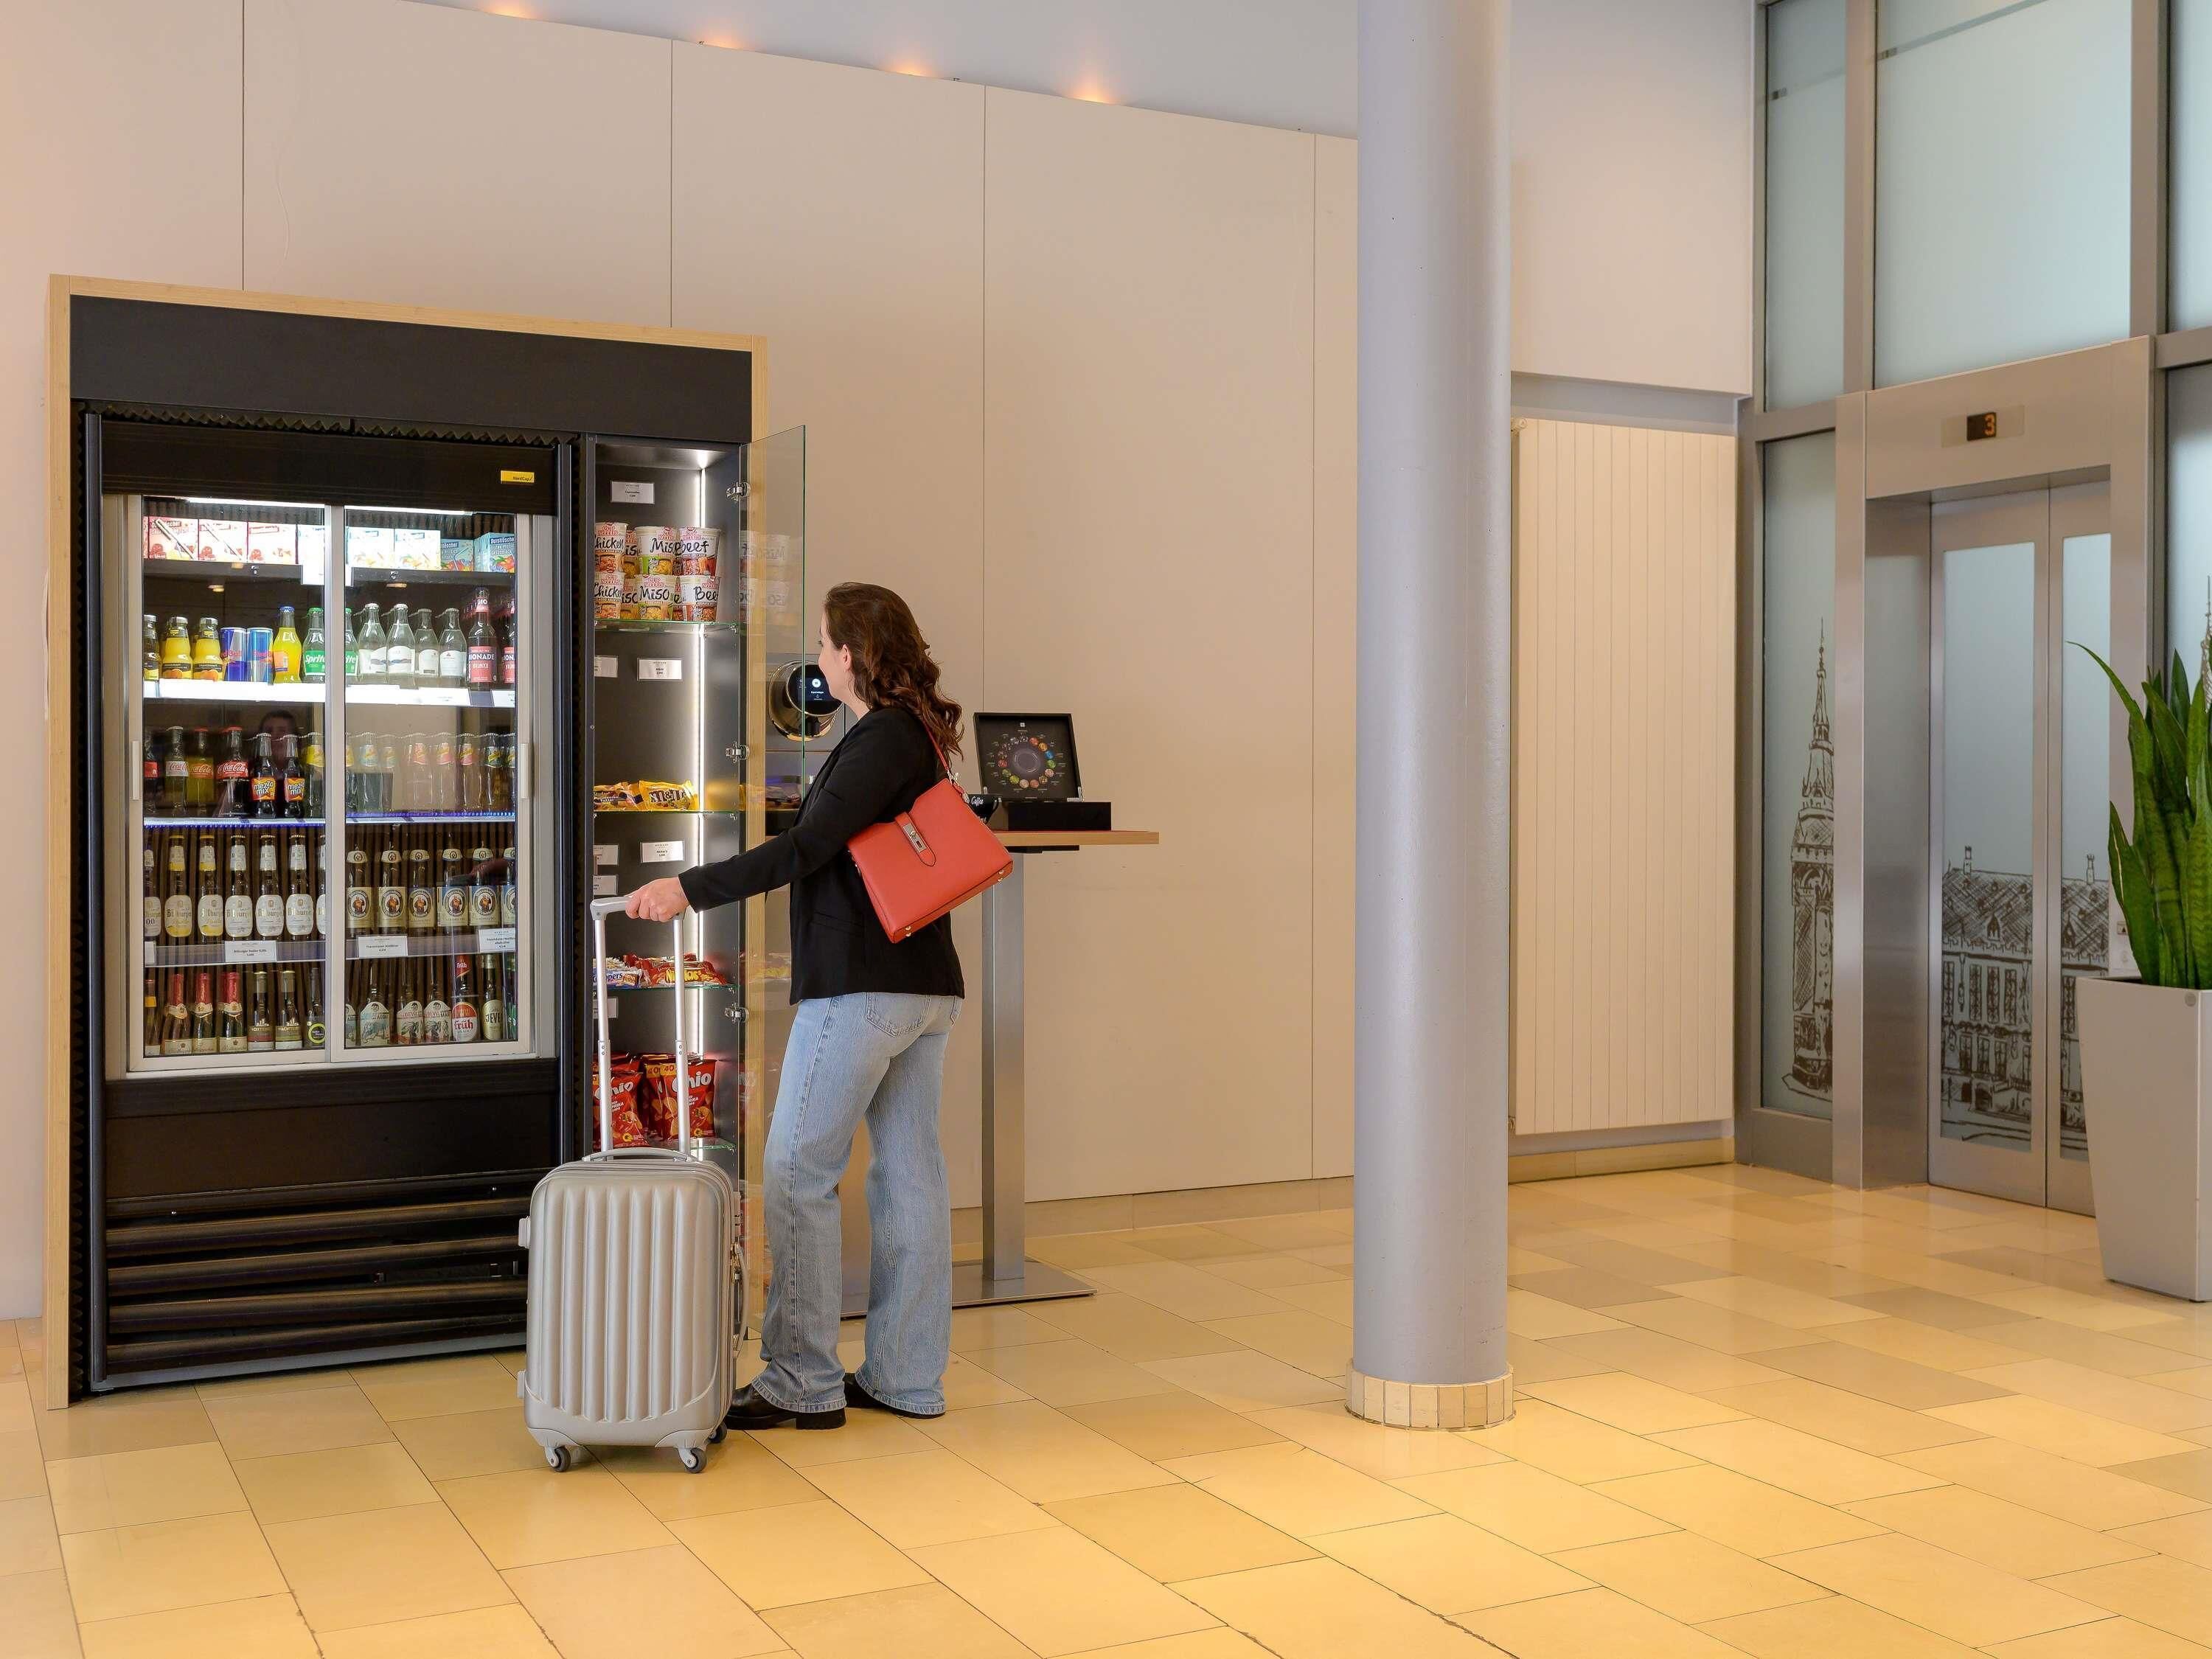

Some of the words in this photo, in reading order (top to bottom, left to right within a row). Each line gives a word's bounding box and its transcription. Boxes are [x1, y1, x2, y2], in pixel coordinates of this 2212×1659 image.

[1983, 414, 1994, 436] 3
[594, 536, 624, 549] hicken
[625, 545, 638, 555] is
[594, 582, 622, 598] Chicke
[640, 585, 669, 601] Miso
[693, 586, 719, 601] Bee
[223, 762, 246, 772] Coca-Cola
[254, 781, 274, 790] mezzo
[256, 786, 270, 795] mix
[971, 796, 984, 807] Coffee
[485, 1012, 502, 1023] JEVE
[594, 1081, 634, 1099] io
